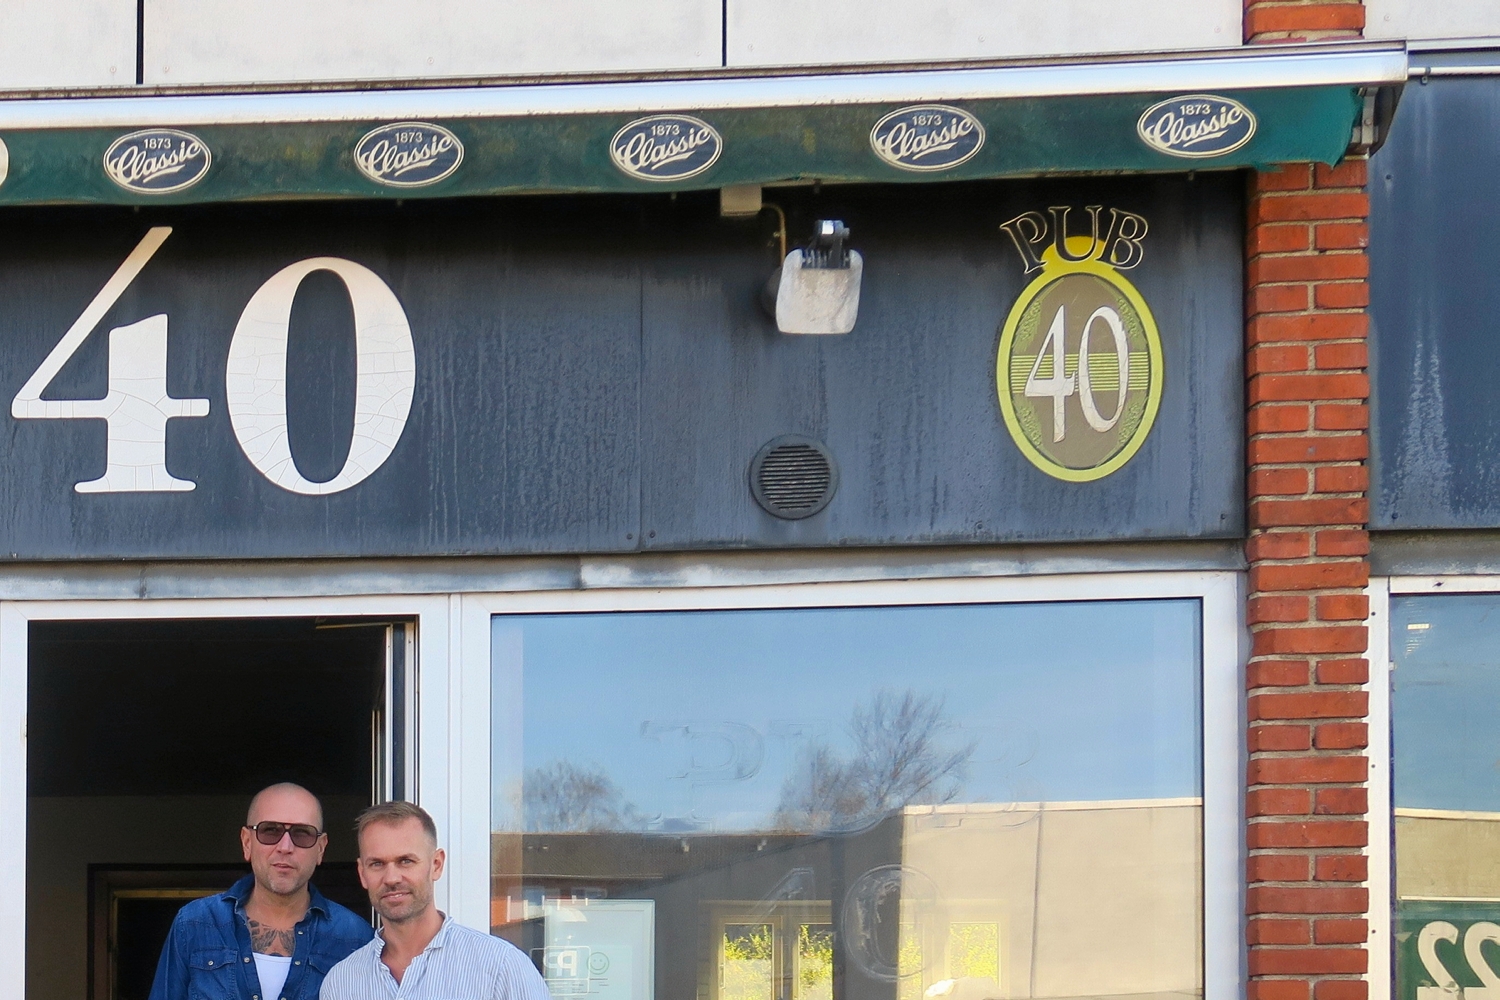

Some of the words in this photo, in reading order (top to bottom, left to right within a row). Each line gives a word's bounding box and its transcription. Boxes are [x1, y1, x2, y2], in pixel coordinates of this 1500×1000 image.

[651, 125, 680, 135] 1873
[912, 114, 942, 126] 1873
[1144, 105, 1242, 148] Classic
[1180, 104, 1210, 115] 1873
[143, 138, 171, 149] 1873
[360, 134, 453, 178] Classic
[395, 132, 423, 143] 1873
[616, 127, 711, 172] Classic
[875, 117, 974, 161] Classic
[110, 141, 201, 184] Classic
[1000, 204, 1150, 275] PUB
[11, 226, 417, 495] 40
[1024, 303, 1130, 443] 40
